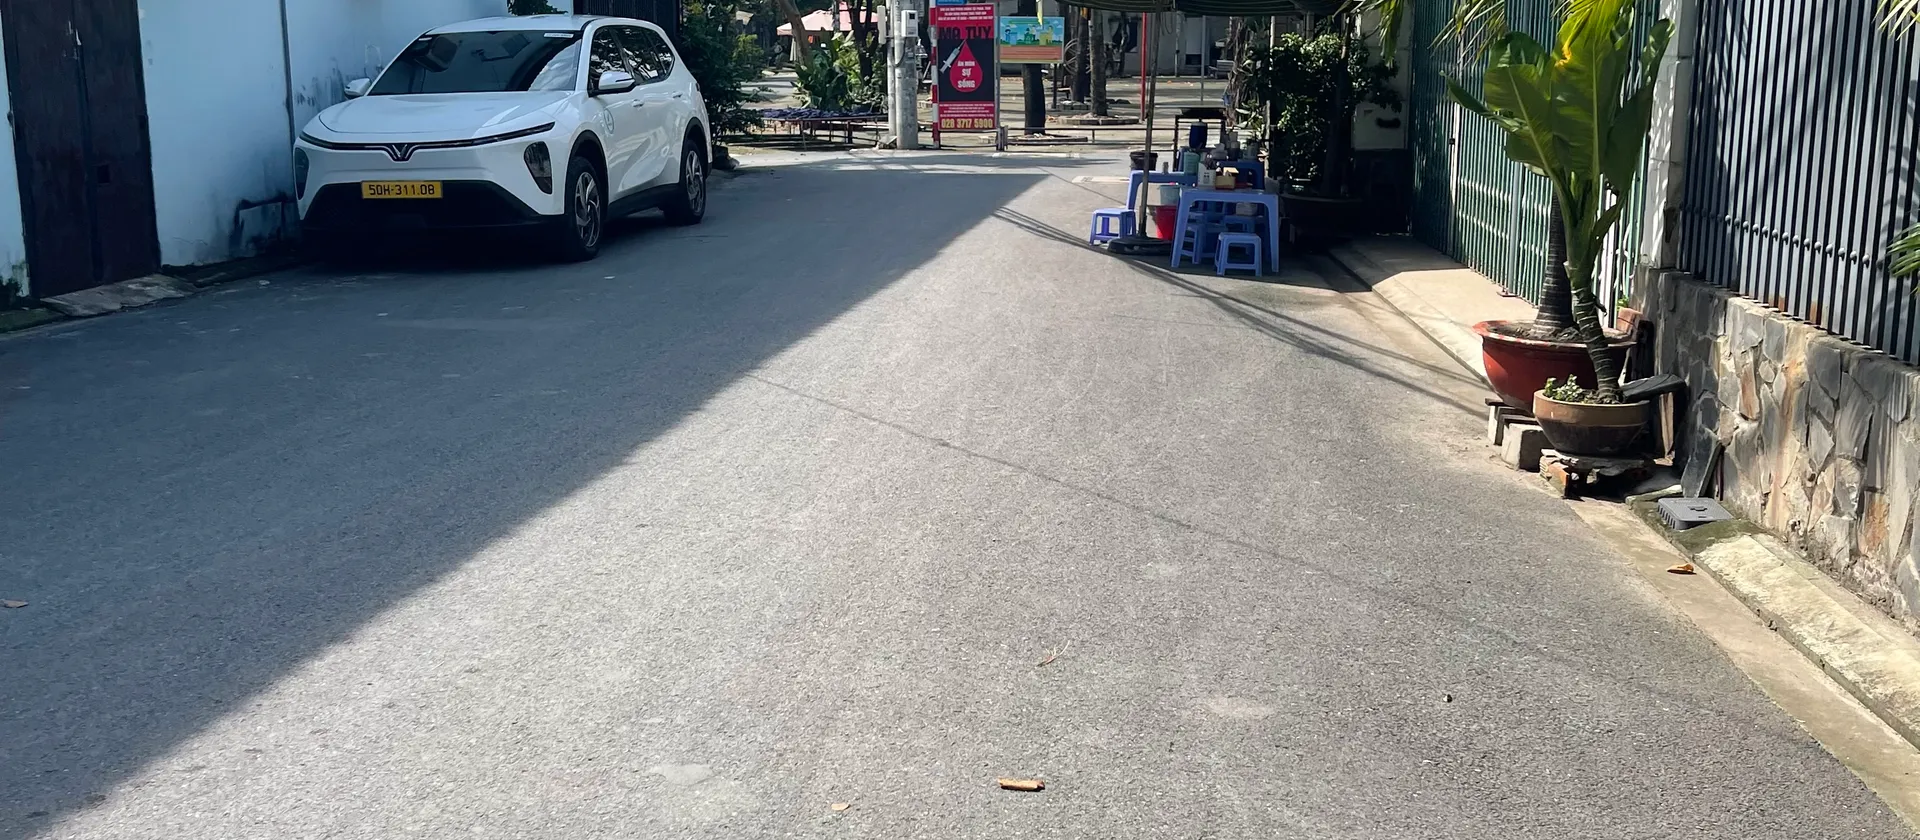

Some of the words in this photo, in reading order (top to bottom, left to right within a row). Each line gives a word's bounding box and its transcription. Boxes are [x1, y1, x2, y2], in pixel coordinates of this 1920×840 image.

[961, 67, 972, 77] SỰ
[941, 118, 955, 129] 028
[956, 118, 973, 129] 3717
[974, 118, 993, 129] 5900
[368, 184, 435, 196] 50H-311.08
